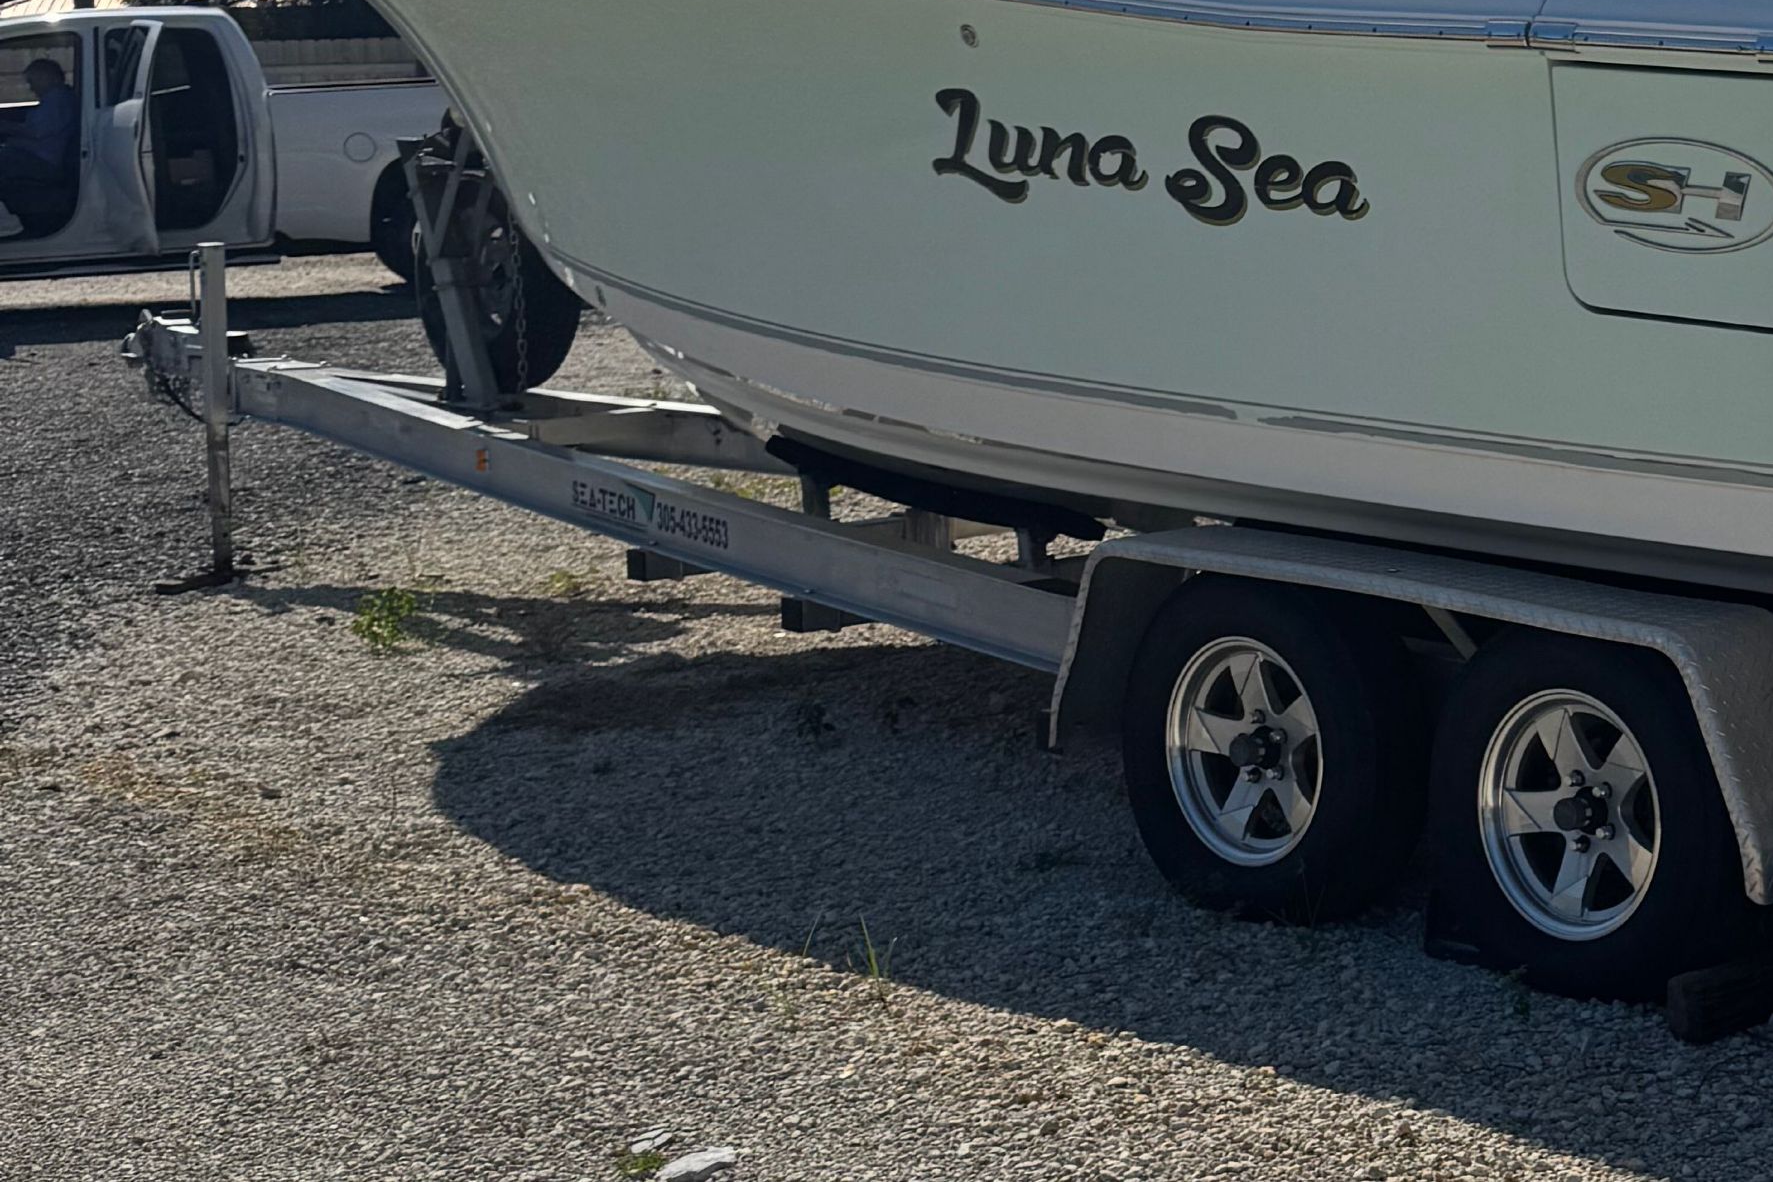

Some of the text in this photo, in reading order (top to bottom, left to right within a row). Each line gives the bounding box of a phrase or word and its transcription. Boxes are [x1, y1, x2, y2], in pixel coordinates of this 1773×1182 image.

[932, 87, 1370, 226] Luna Sea
[572, 480, 636, 520] SEA-TECH
